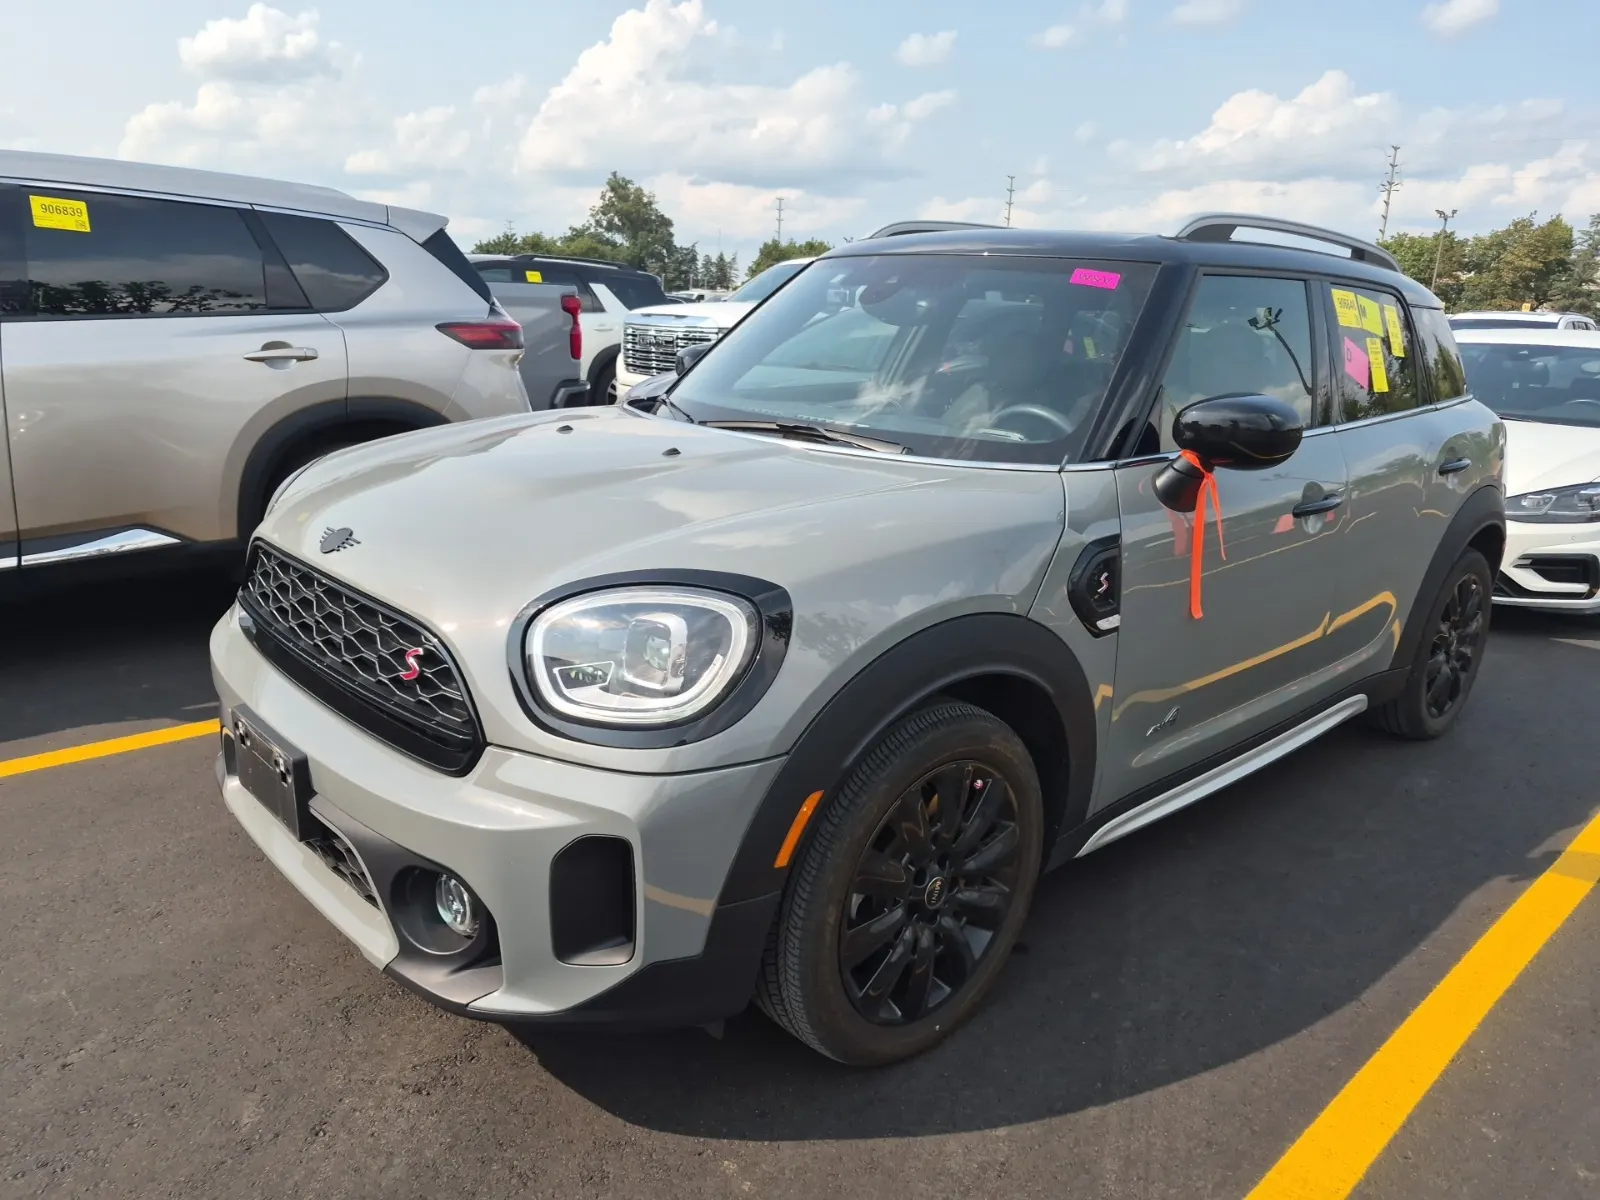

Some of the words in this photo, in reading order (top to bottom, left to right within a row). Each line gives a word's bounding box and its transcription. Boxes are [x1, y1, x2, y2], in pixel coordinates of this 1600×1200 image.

[40, 203, 83, 217] 906839
[400, 647, 424, 680] S
[930, 881, 942, 903] MINI
